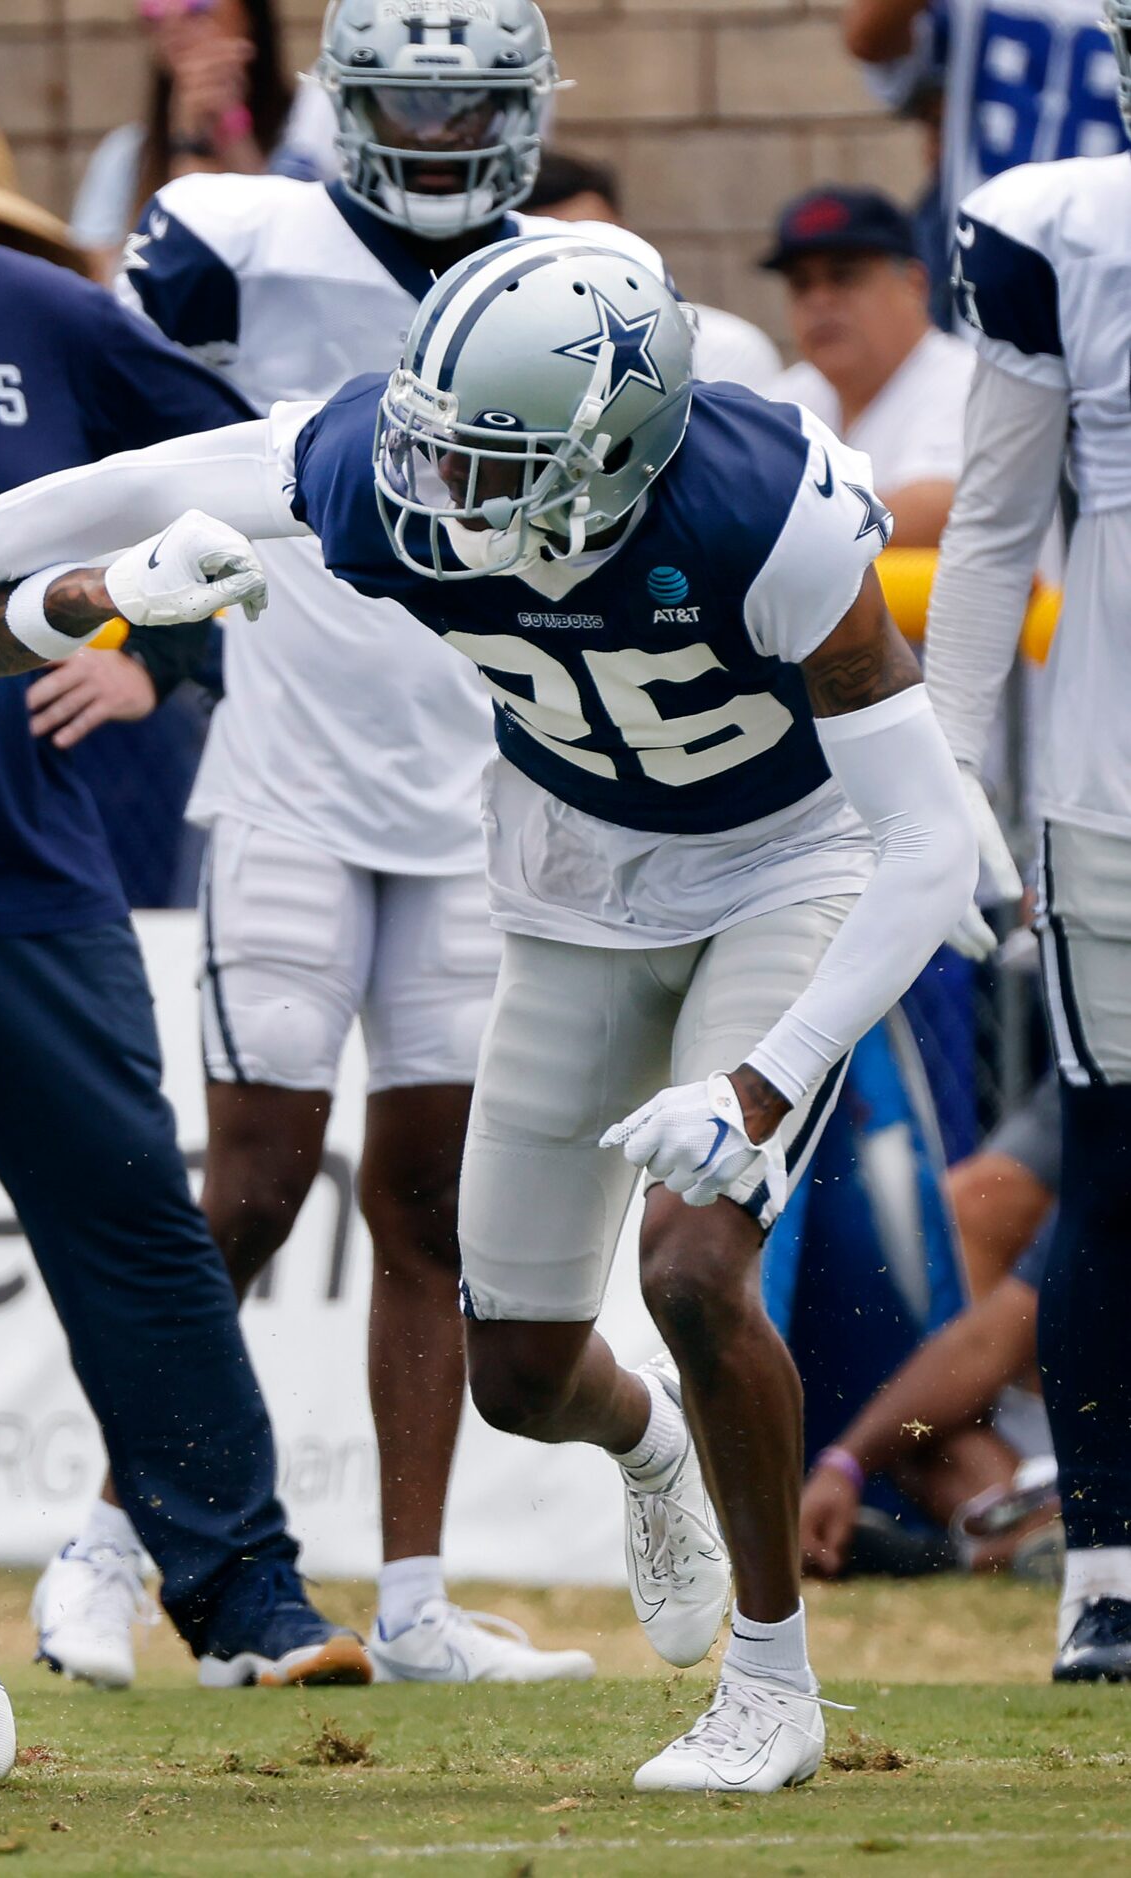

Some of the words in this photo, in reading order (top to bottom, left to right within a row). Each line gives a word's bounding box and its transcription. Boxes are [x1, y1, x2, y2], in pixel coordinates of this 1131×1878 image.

[518, 612, 604, 629] COWBOYS
[653, 606, 701, 624] AT&T
[437, 630, 795, 787] 25
